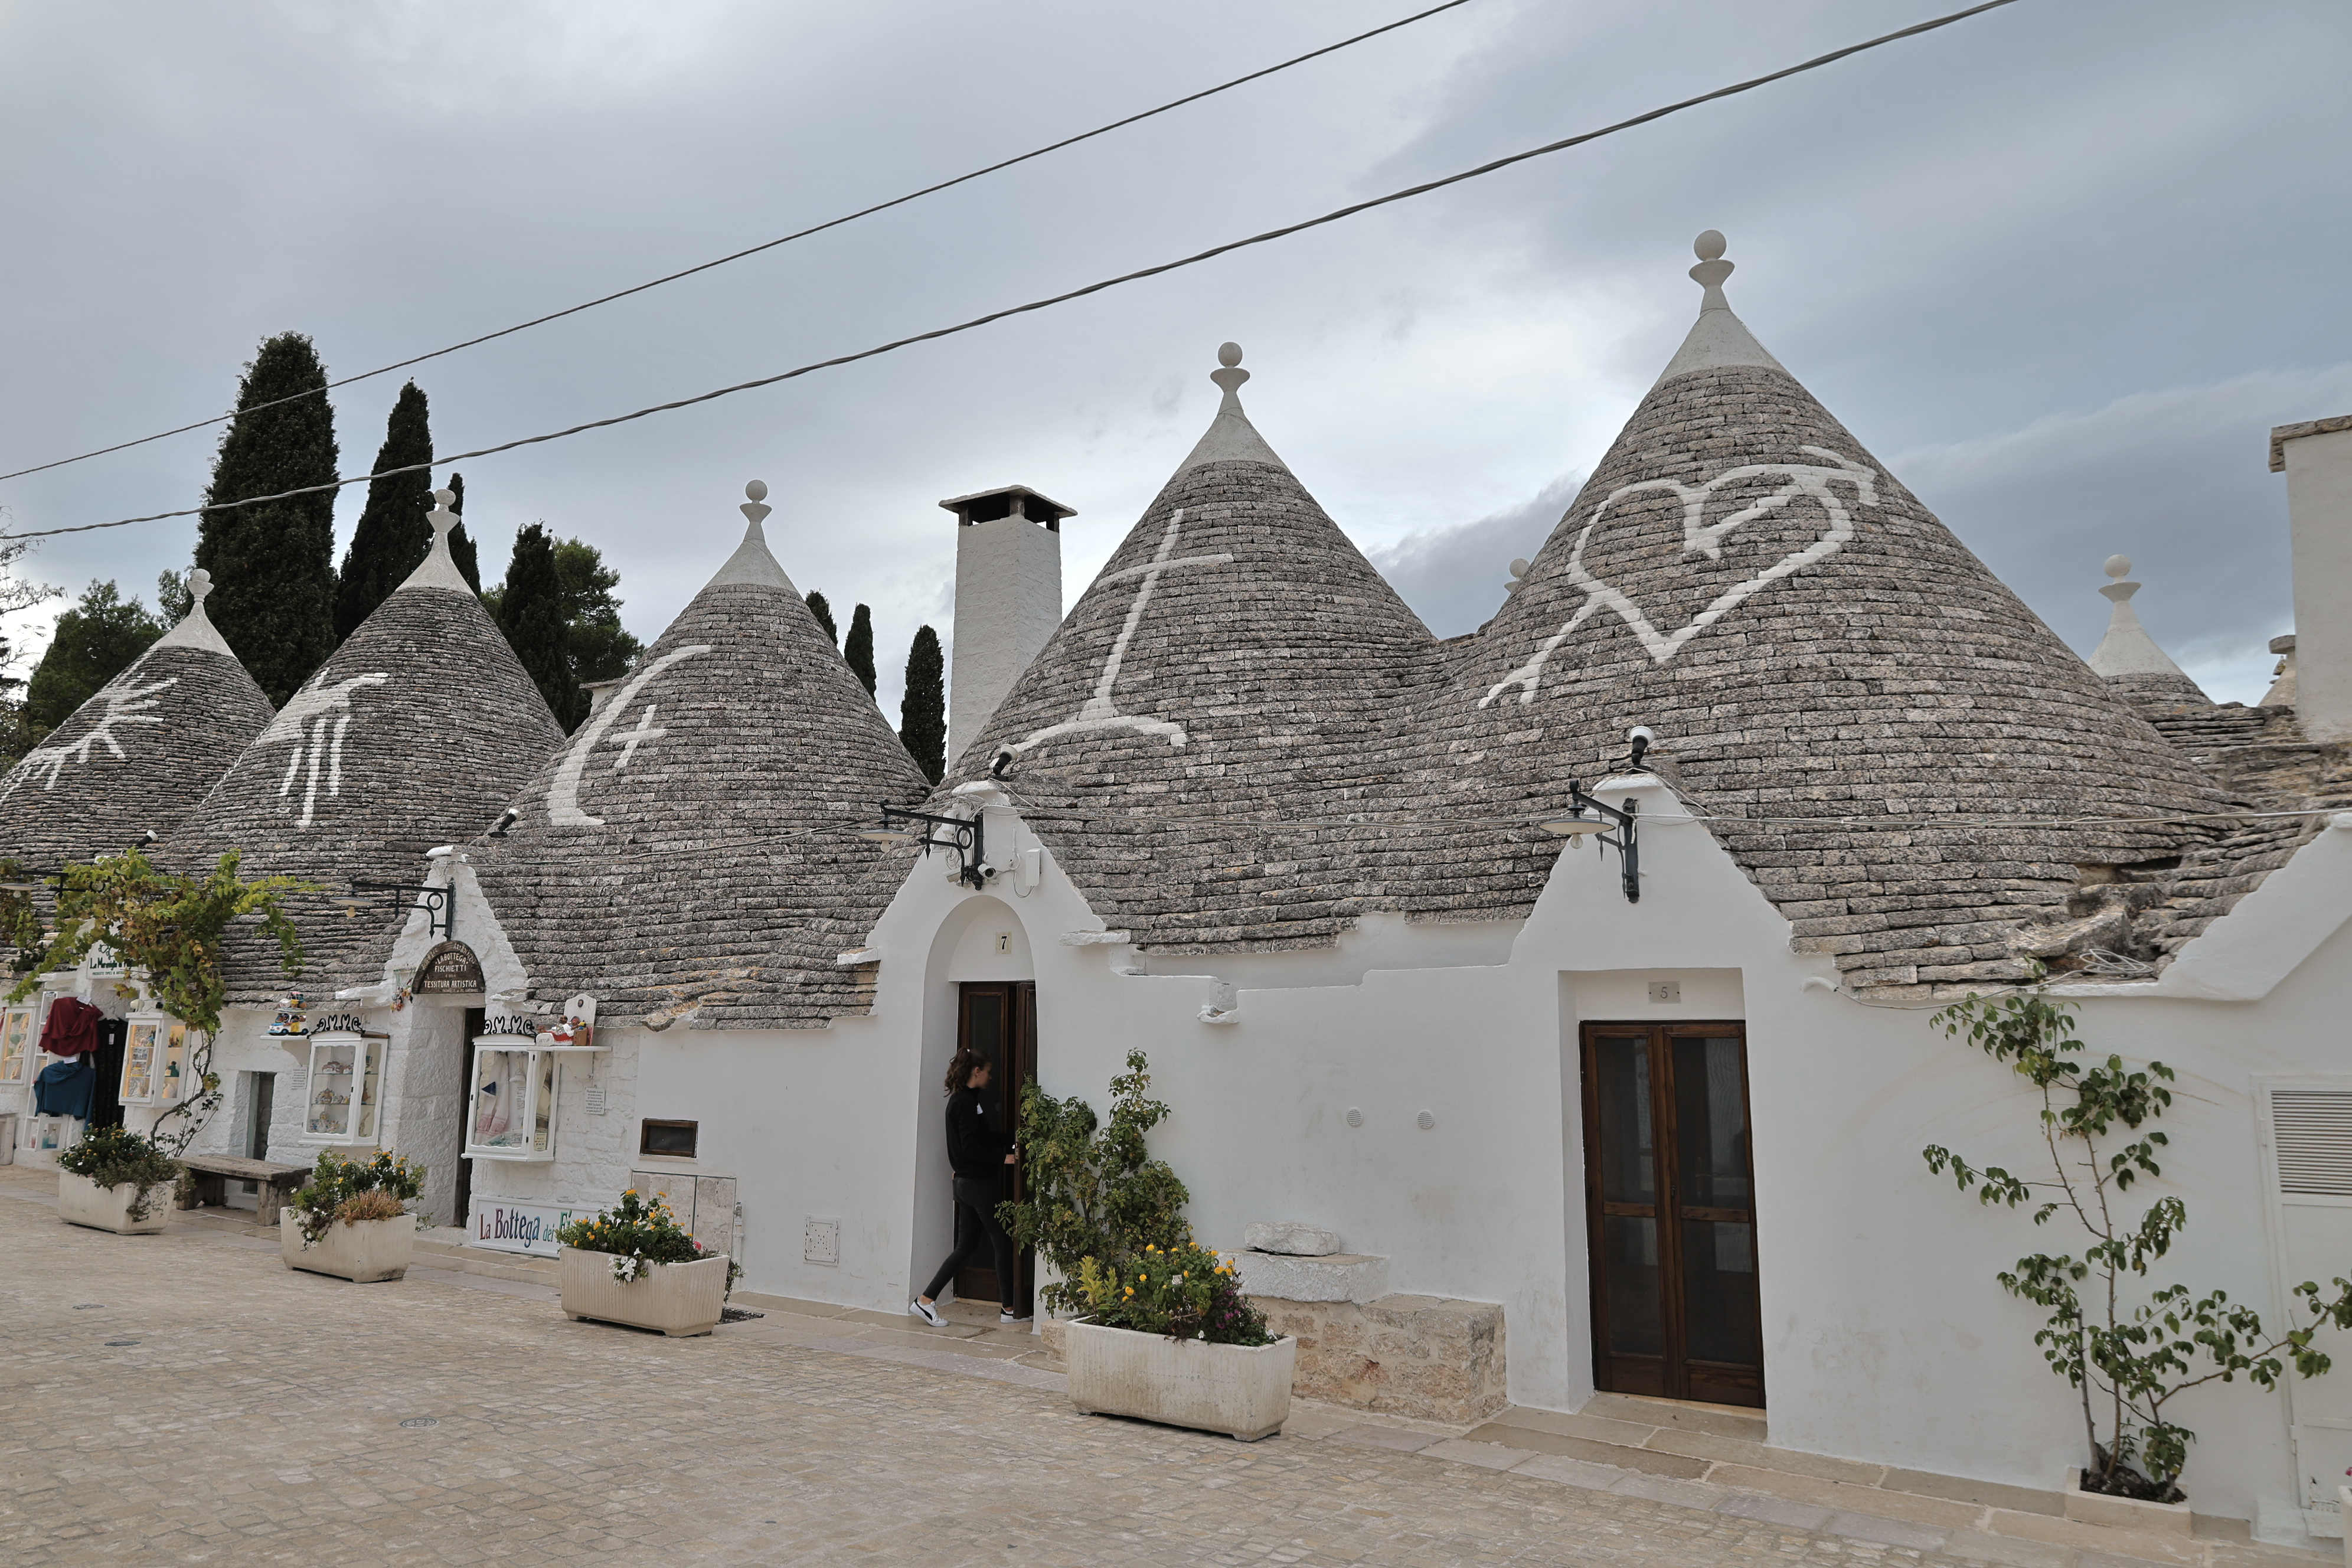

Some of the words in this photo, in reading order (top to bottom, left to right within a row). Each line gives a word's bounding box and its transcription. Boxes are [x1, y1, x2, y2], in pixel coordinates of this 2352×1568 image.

[1001, 936, 1007, 949] 7
[1660, 986, 1668, 999] 5
[479, 1214, 491, 1240] La
[494, 1207, 540, 1248] Bottega
[543, 1223, 554, 1242] dei
